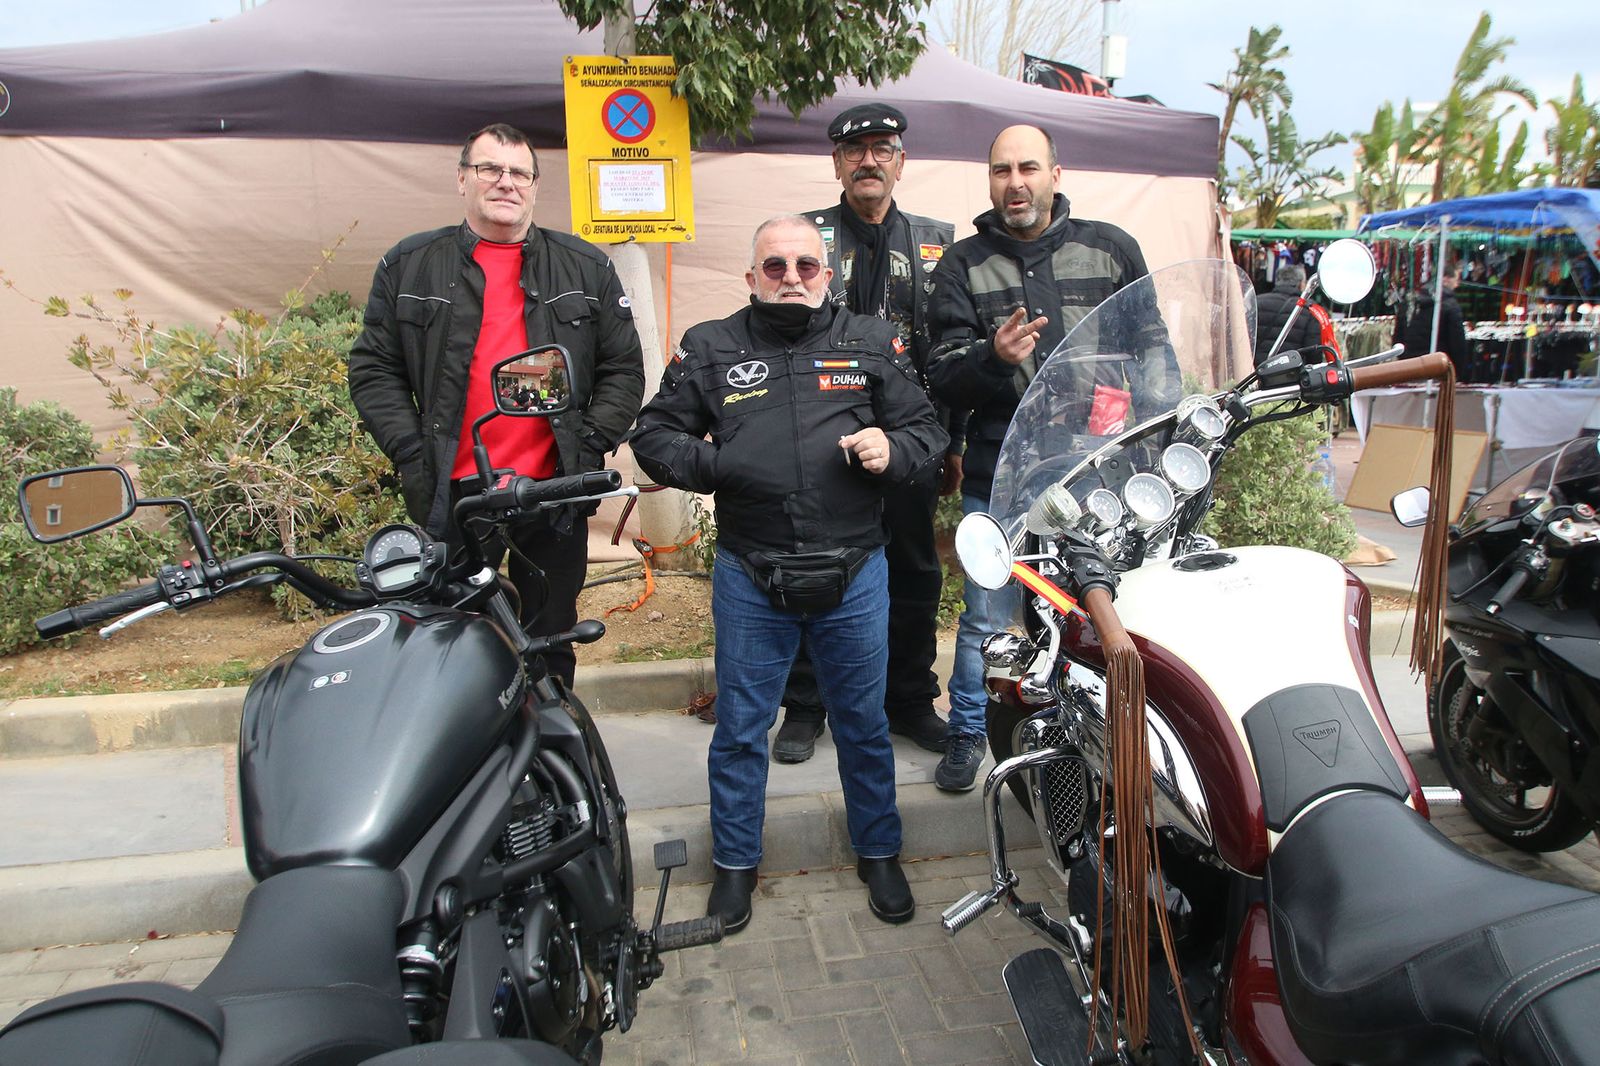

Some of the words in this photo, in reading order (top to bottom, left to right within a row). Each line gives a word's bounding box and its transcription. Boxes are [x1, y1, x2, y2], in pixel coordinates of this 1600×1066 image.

[583, 65, 637, 76] AYUNTAMIENTO
[612, 147, 650, 158] MOTIVO
[593, 224, 613, 234] JEFATURA
[614, 225, 620, 234] DE
[621, 224, 626, 233] LA
[643, 224, 656, 233] LOCAL
[832, 375, 867, 385] DUHAN
[1300, 727, 1337, 740] TRIUMPH
